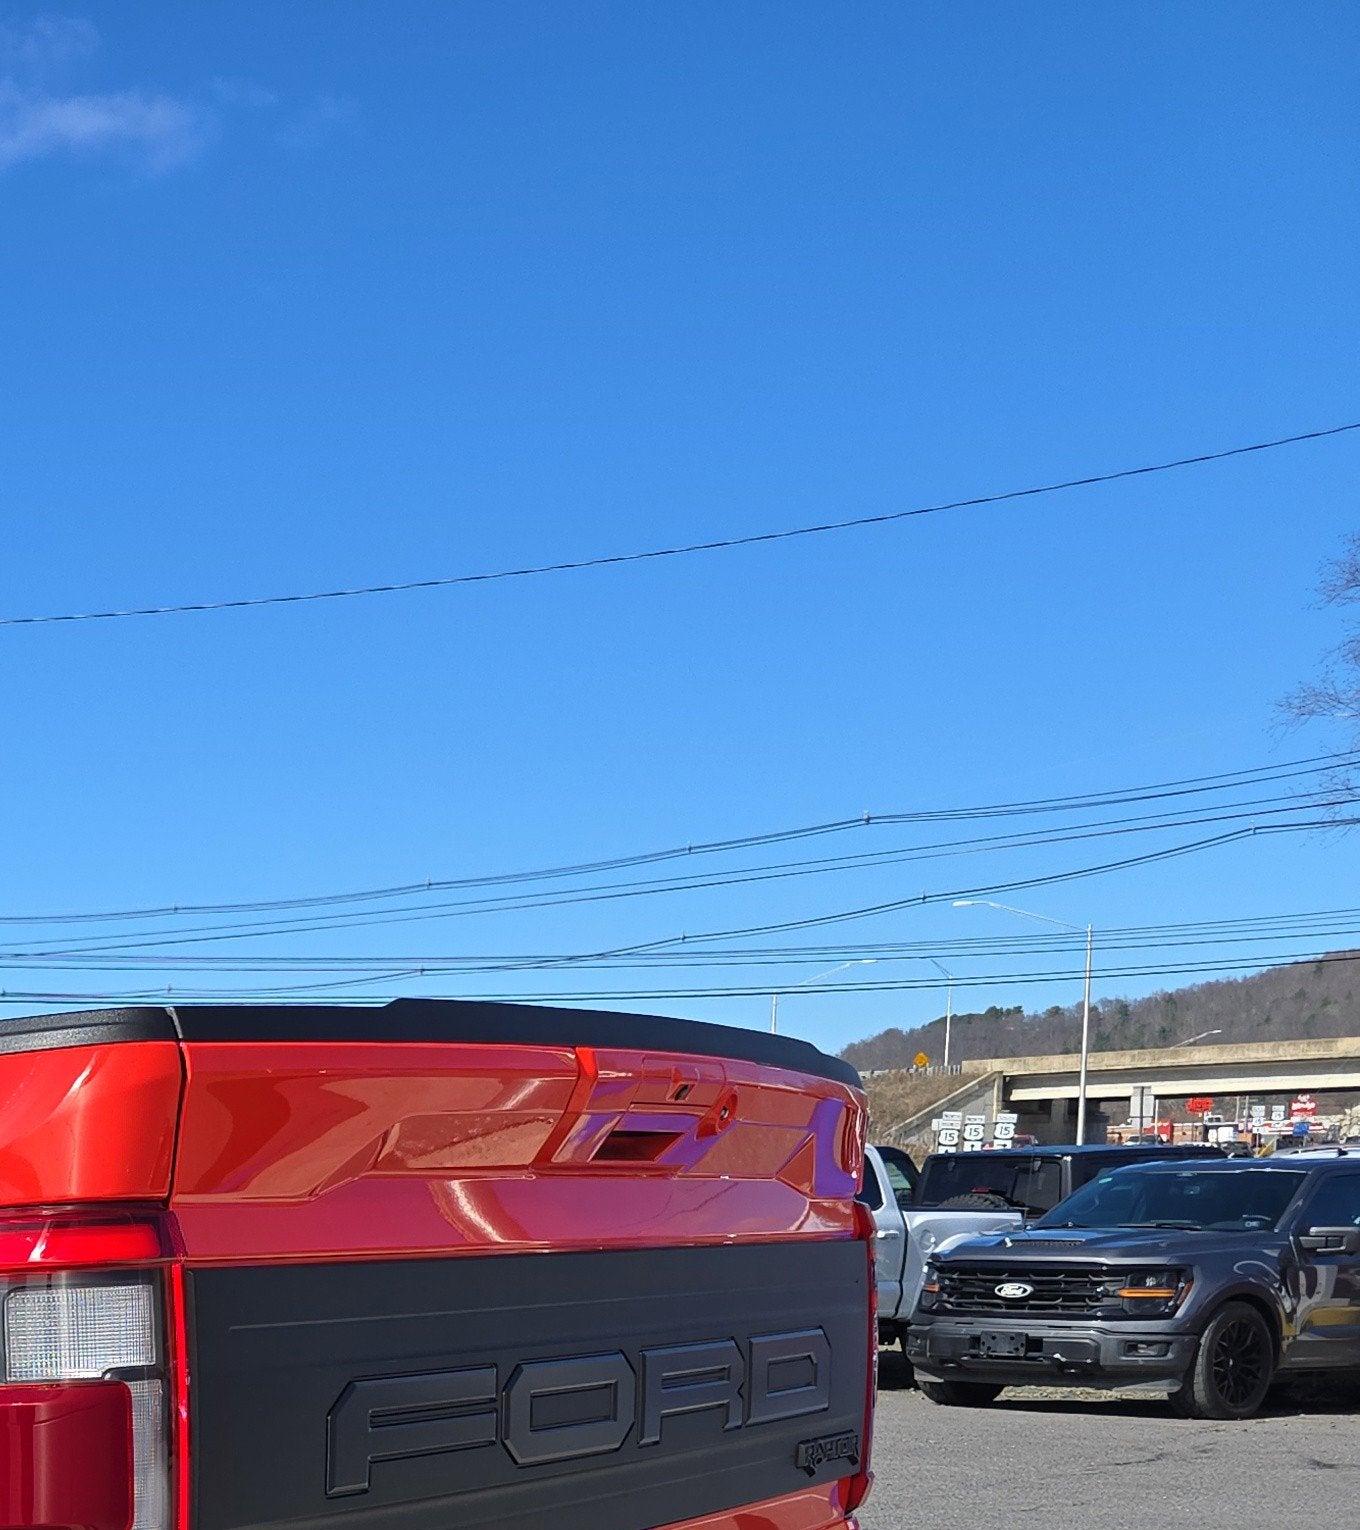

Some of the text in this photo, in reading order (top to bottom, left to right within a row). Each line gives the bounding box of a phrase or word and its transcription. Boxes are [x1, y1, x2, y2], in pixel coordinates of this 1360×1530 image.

[969, 1127, 980, 1137] 15
[999, 1126, 1011, 1136] 15
[944, 1132, 955, 1142] 15
[325, 1325, 833, 1499] FORD
